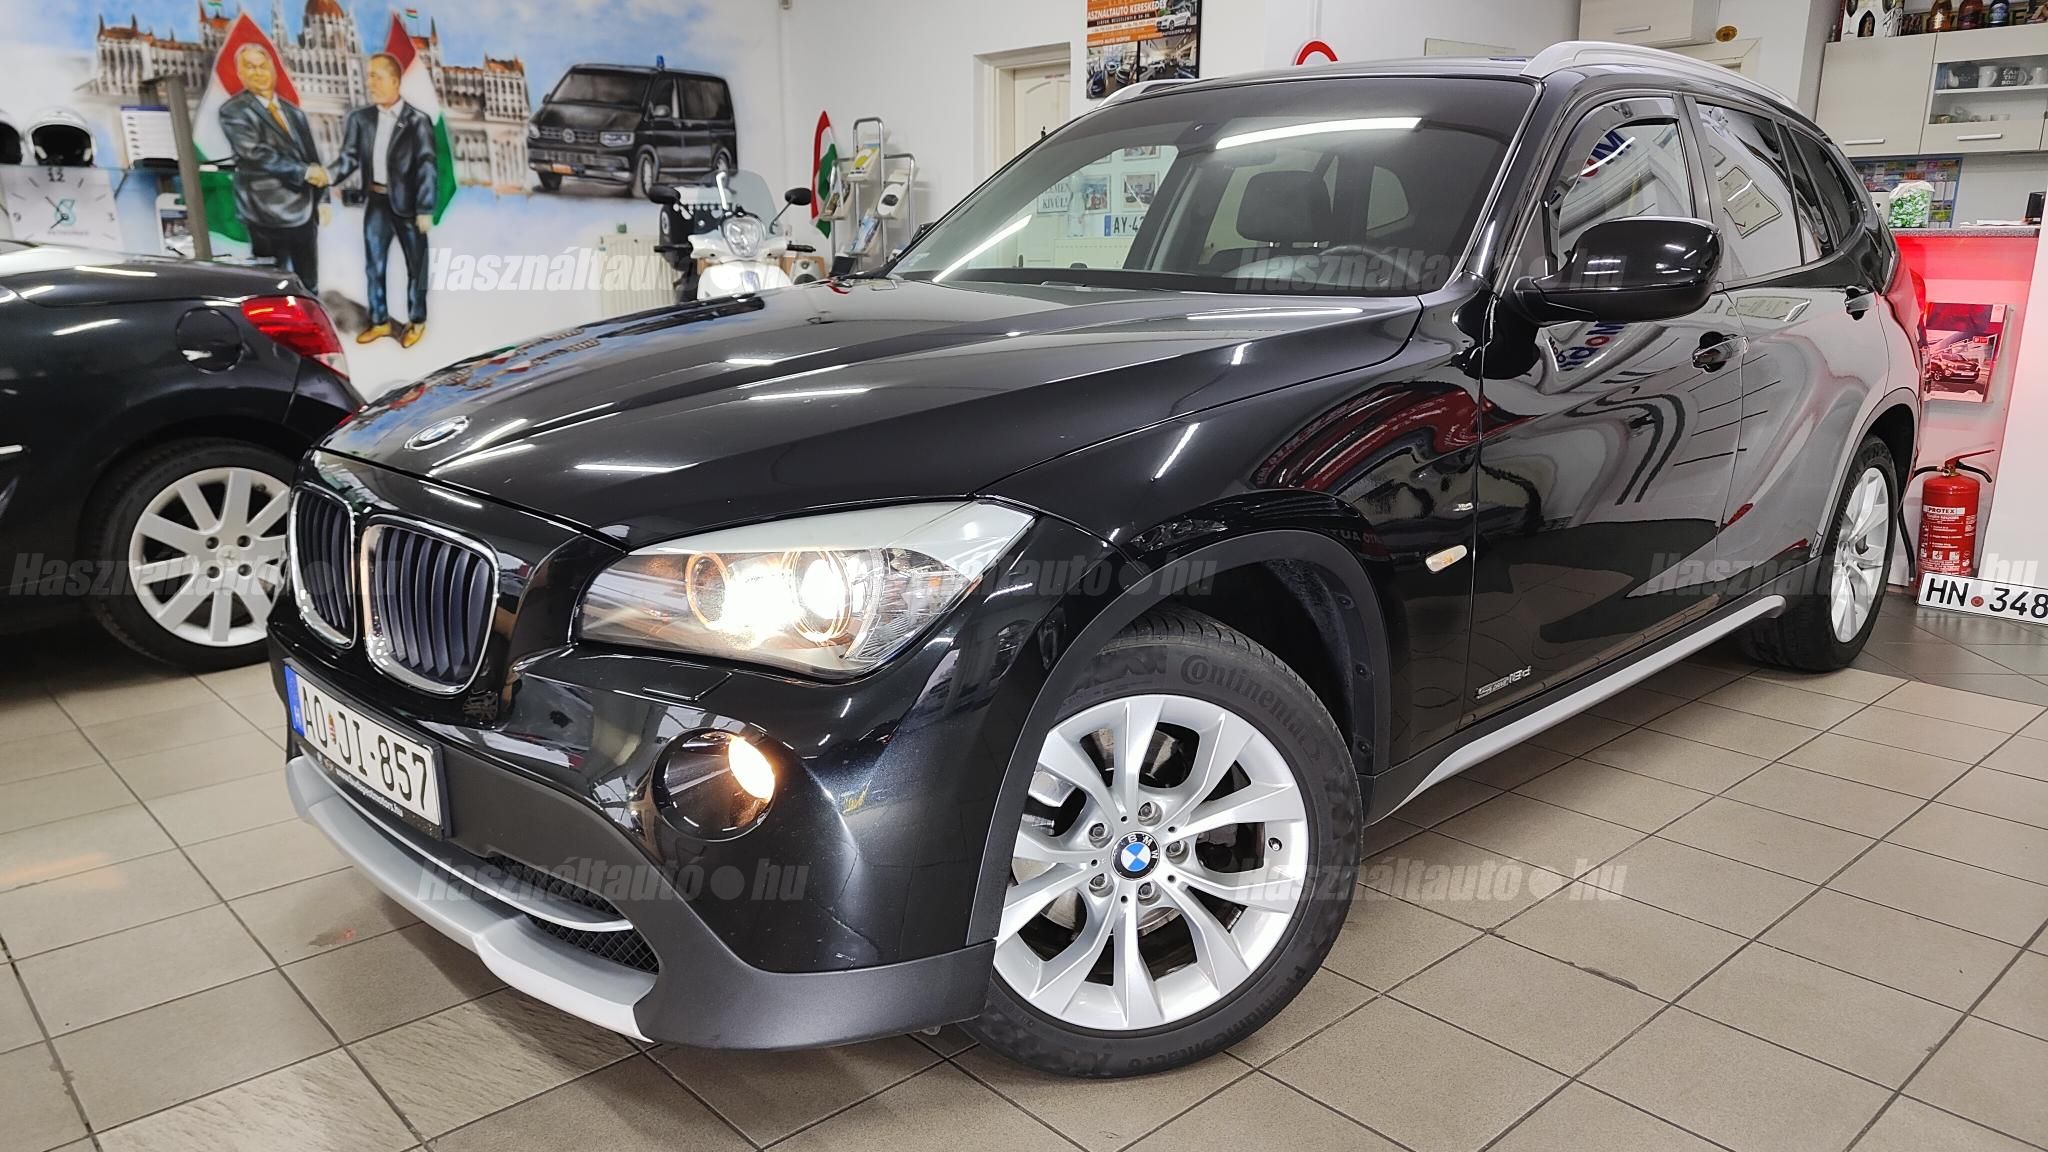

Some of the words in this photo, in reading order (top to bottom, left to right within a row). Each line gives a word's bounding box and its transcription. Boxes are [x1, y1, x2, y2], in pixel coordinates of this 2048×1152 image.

[1928, 506, 1955, 514] PROTEX
[1926, 578, 1969, 606] HN
[1989, 587, 2048, 619] 348
[302, 685, 328, 749] AO
[338, 711, 428, 811] JI-857
[1127, 833, 1159, 859] BMW
